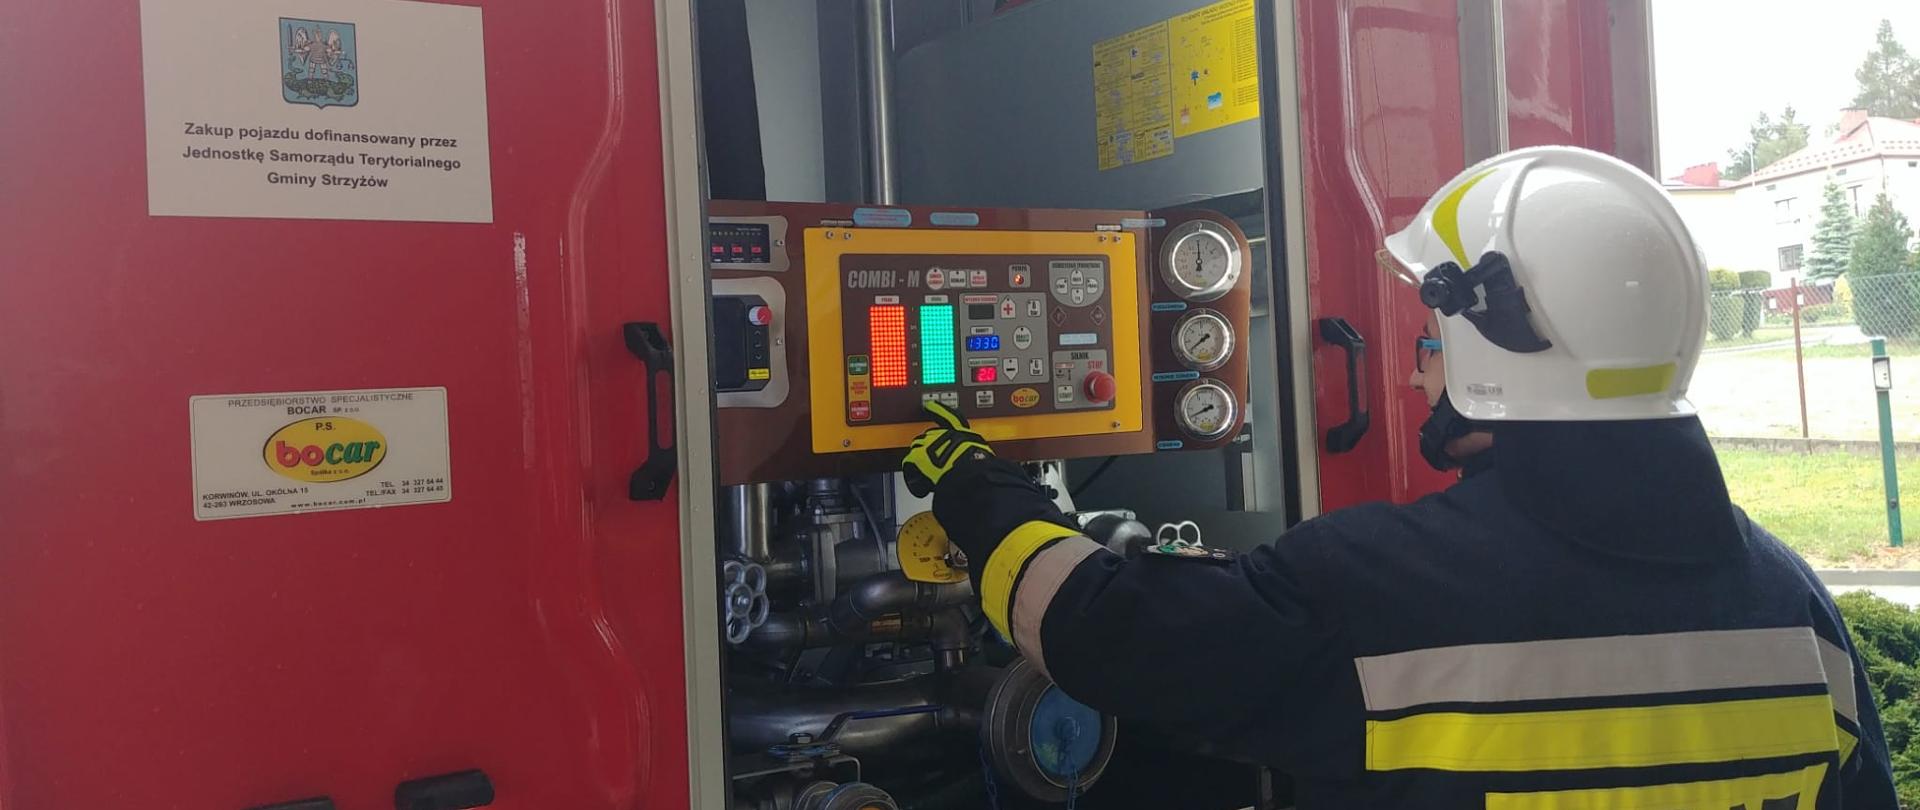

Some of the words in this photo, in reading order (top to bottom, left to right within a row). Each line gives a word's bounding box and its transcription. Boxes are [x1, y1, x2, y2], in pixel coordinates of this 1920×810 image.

[184, 122, 234, 139] Zakup
[239, 126, 300, 141] pojazdu
[304, 128, 416, 148] dofinansowany
[420, 136, 458, 151] przez
[182, 146, 264, 164] Jednostkę
[269, 149, 355, 167] Samorządu
[359, 154, 461, 172] Terytorialnego
[267, 172, 317, 188] Gminy
[321, 173, 388, 190] Strzyżów
[848, 270, 896, 288] COMBI
[907, 270, 920, 288] M
[969, 336, 998, 349] 1330
[1088, 360, 1103, 369] STOP
[228, 396, 326, 409] PRZEDSIĘBIORSTWO
[331, 392, 413, 404] SPECJALISTYCZNE
[1013, 394, 1038, 402] bocar
[287, 405, 327, 415] BOCAR
[276, 440, 380, 468] bocar
[265, 486, 298, 496] OKÓLNA
[229, 497, 276, 507] WRZOSOWA
